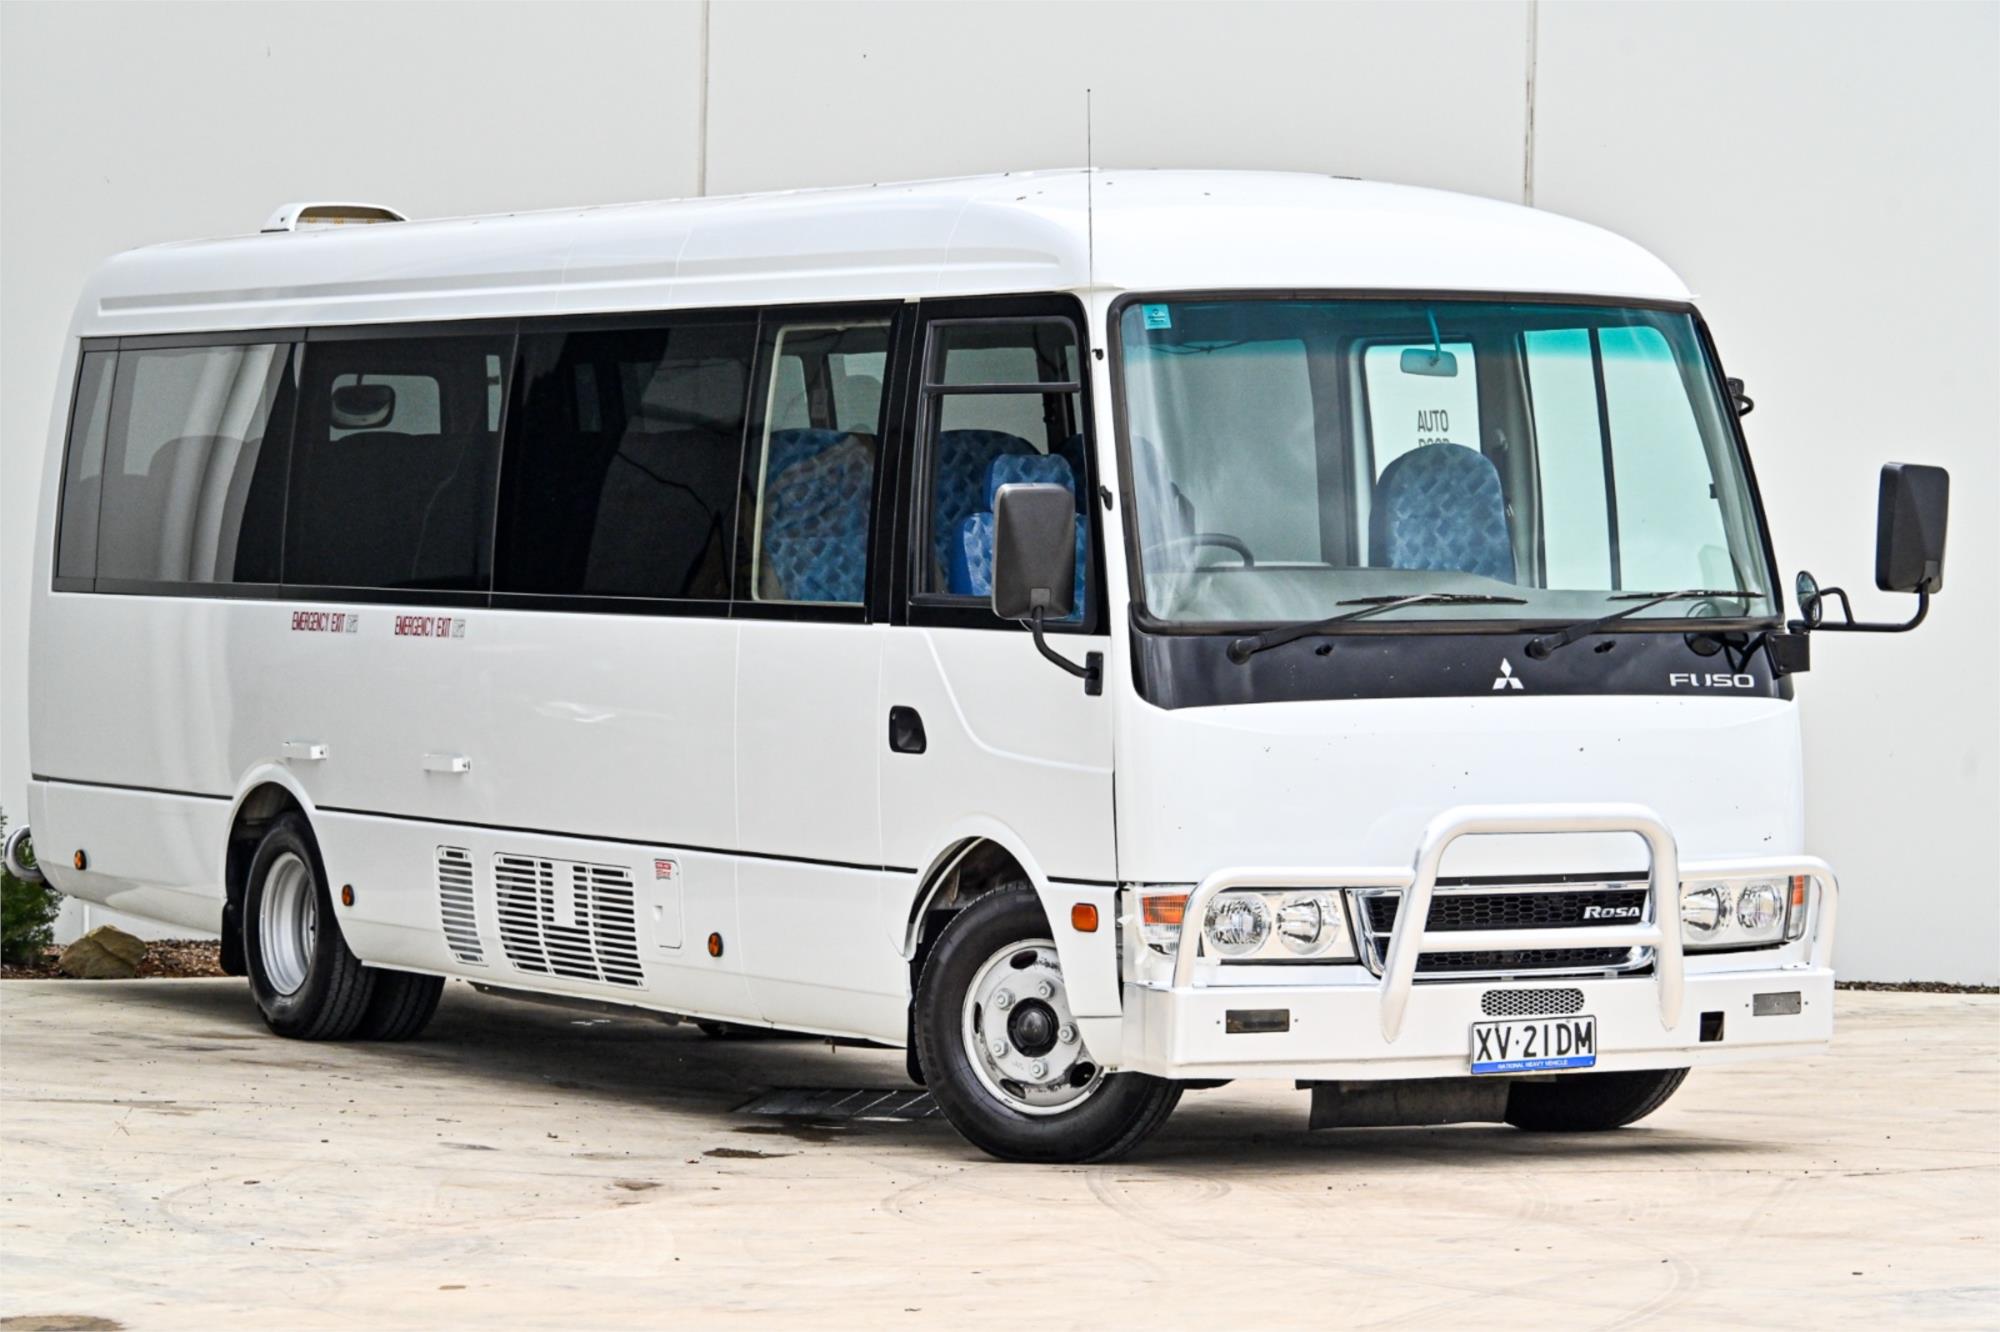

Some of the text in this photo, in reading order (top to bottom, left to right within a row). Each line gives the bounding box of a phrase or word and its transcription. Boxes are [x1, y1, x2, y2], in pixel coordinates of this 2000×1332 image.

[1417, 409, 1449, 432] AUTO
[292, 611, 345, 632] EMERGENCY EXIT
[394, 616, 451, 637] EMERGENCY EXIT
[1669, 673, 1755, 688] FUSO
[1545, 1059, 1568, 1067] VEHICLE
